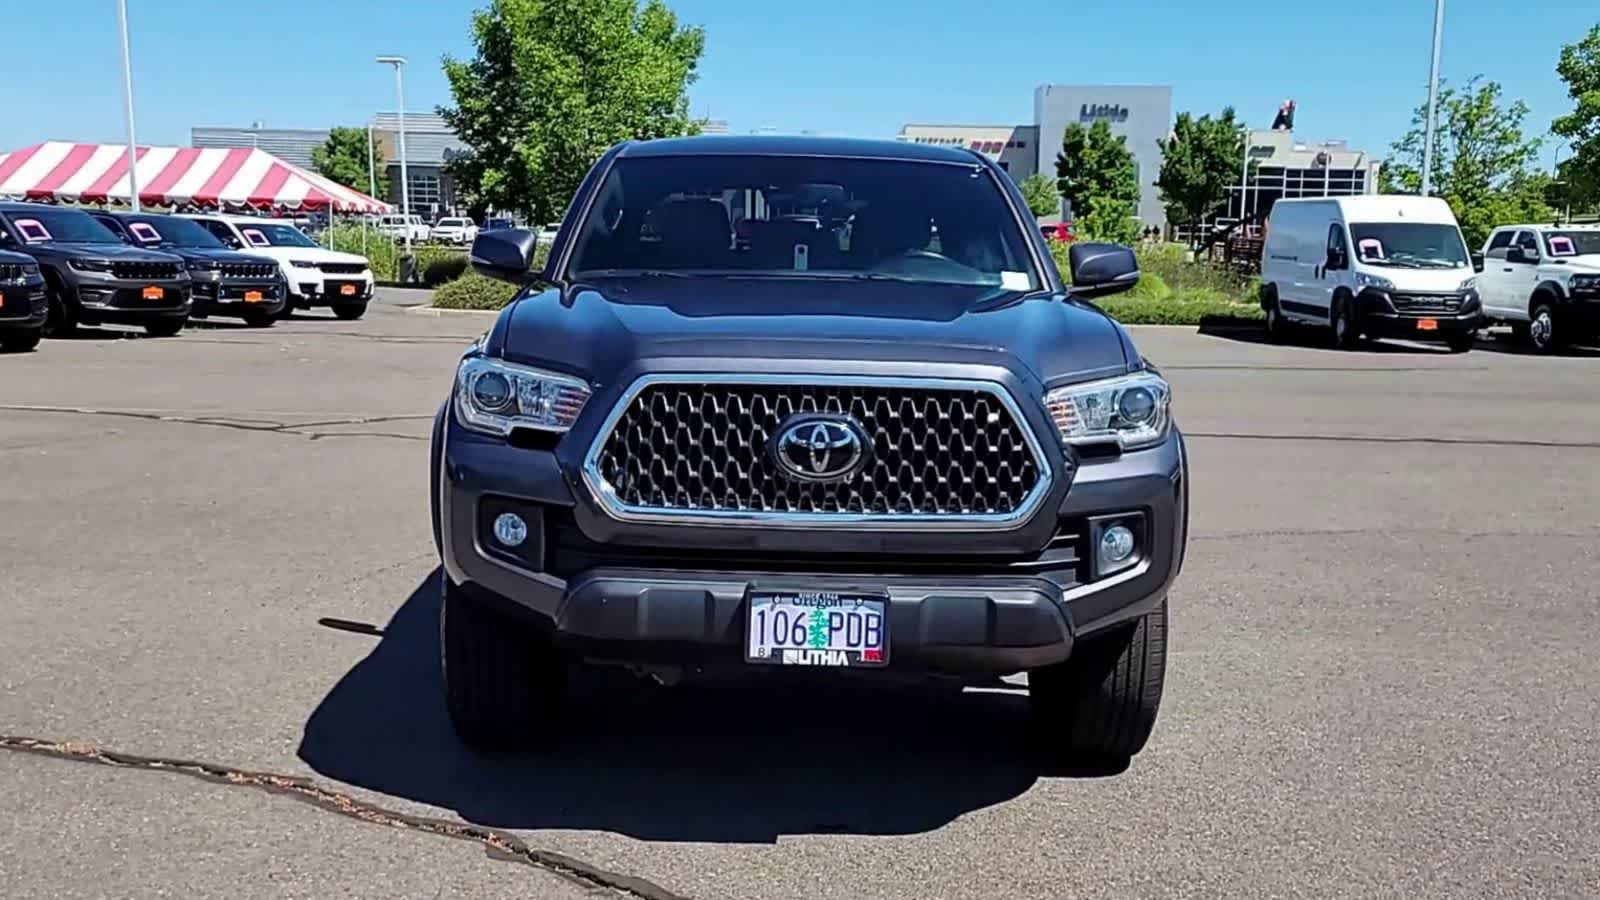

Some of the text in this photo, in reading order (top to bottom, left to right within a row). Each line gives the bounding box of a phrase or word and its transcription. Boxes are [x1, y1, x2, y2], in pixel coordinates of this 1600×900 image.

[757, 609, 882, 648] 106 PDB
[799, 650, 849, 667] LITHIA
